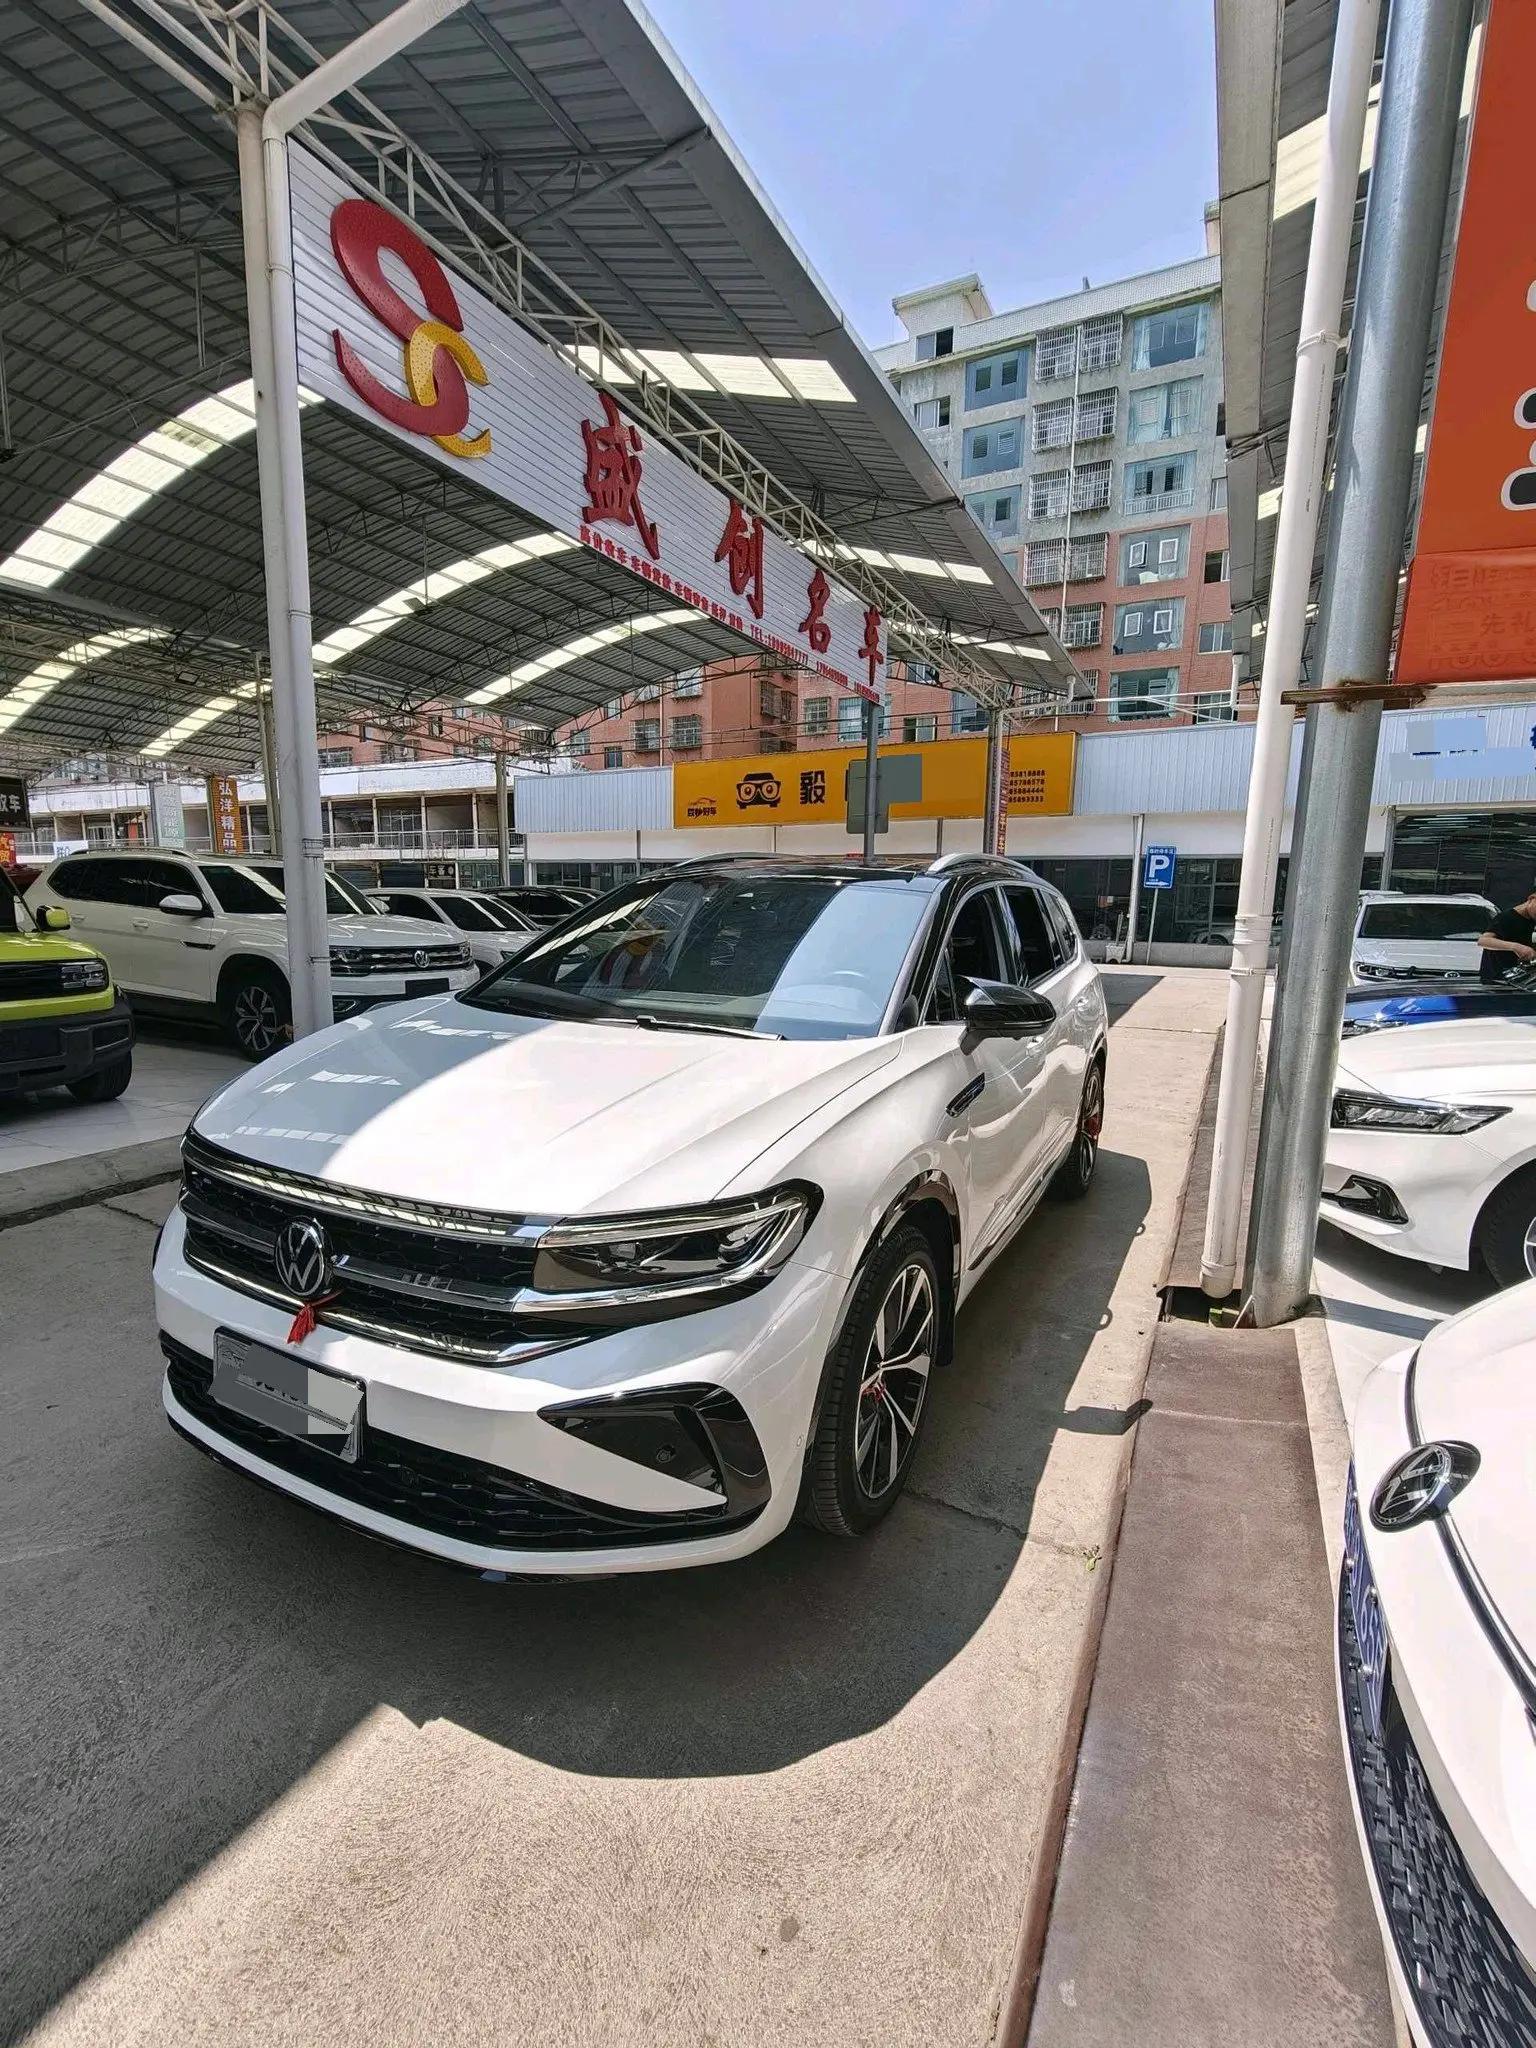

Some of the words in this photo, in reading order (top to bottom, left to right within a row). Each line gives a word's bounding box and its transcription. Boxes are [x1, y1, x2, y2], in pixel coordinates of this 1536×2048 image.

[218, 781, 237, 854] 弘洋精品
[1148, 855, 1170, 878] P
